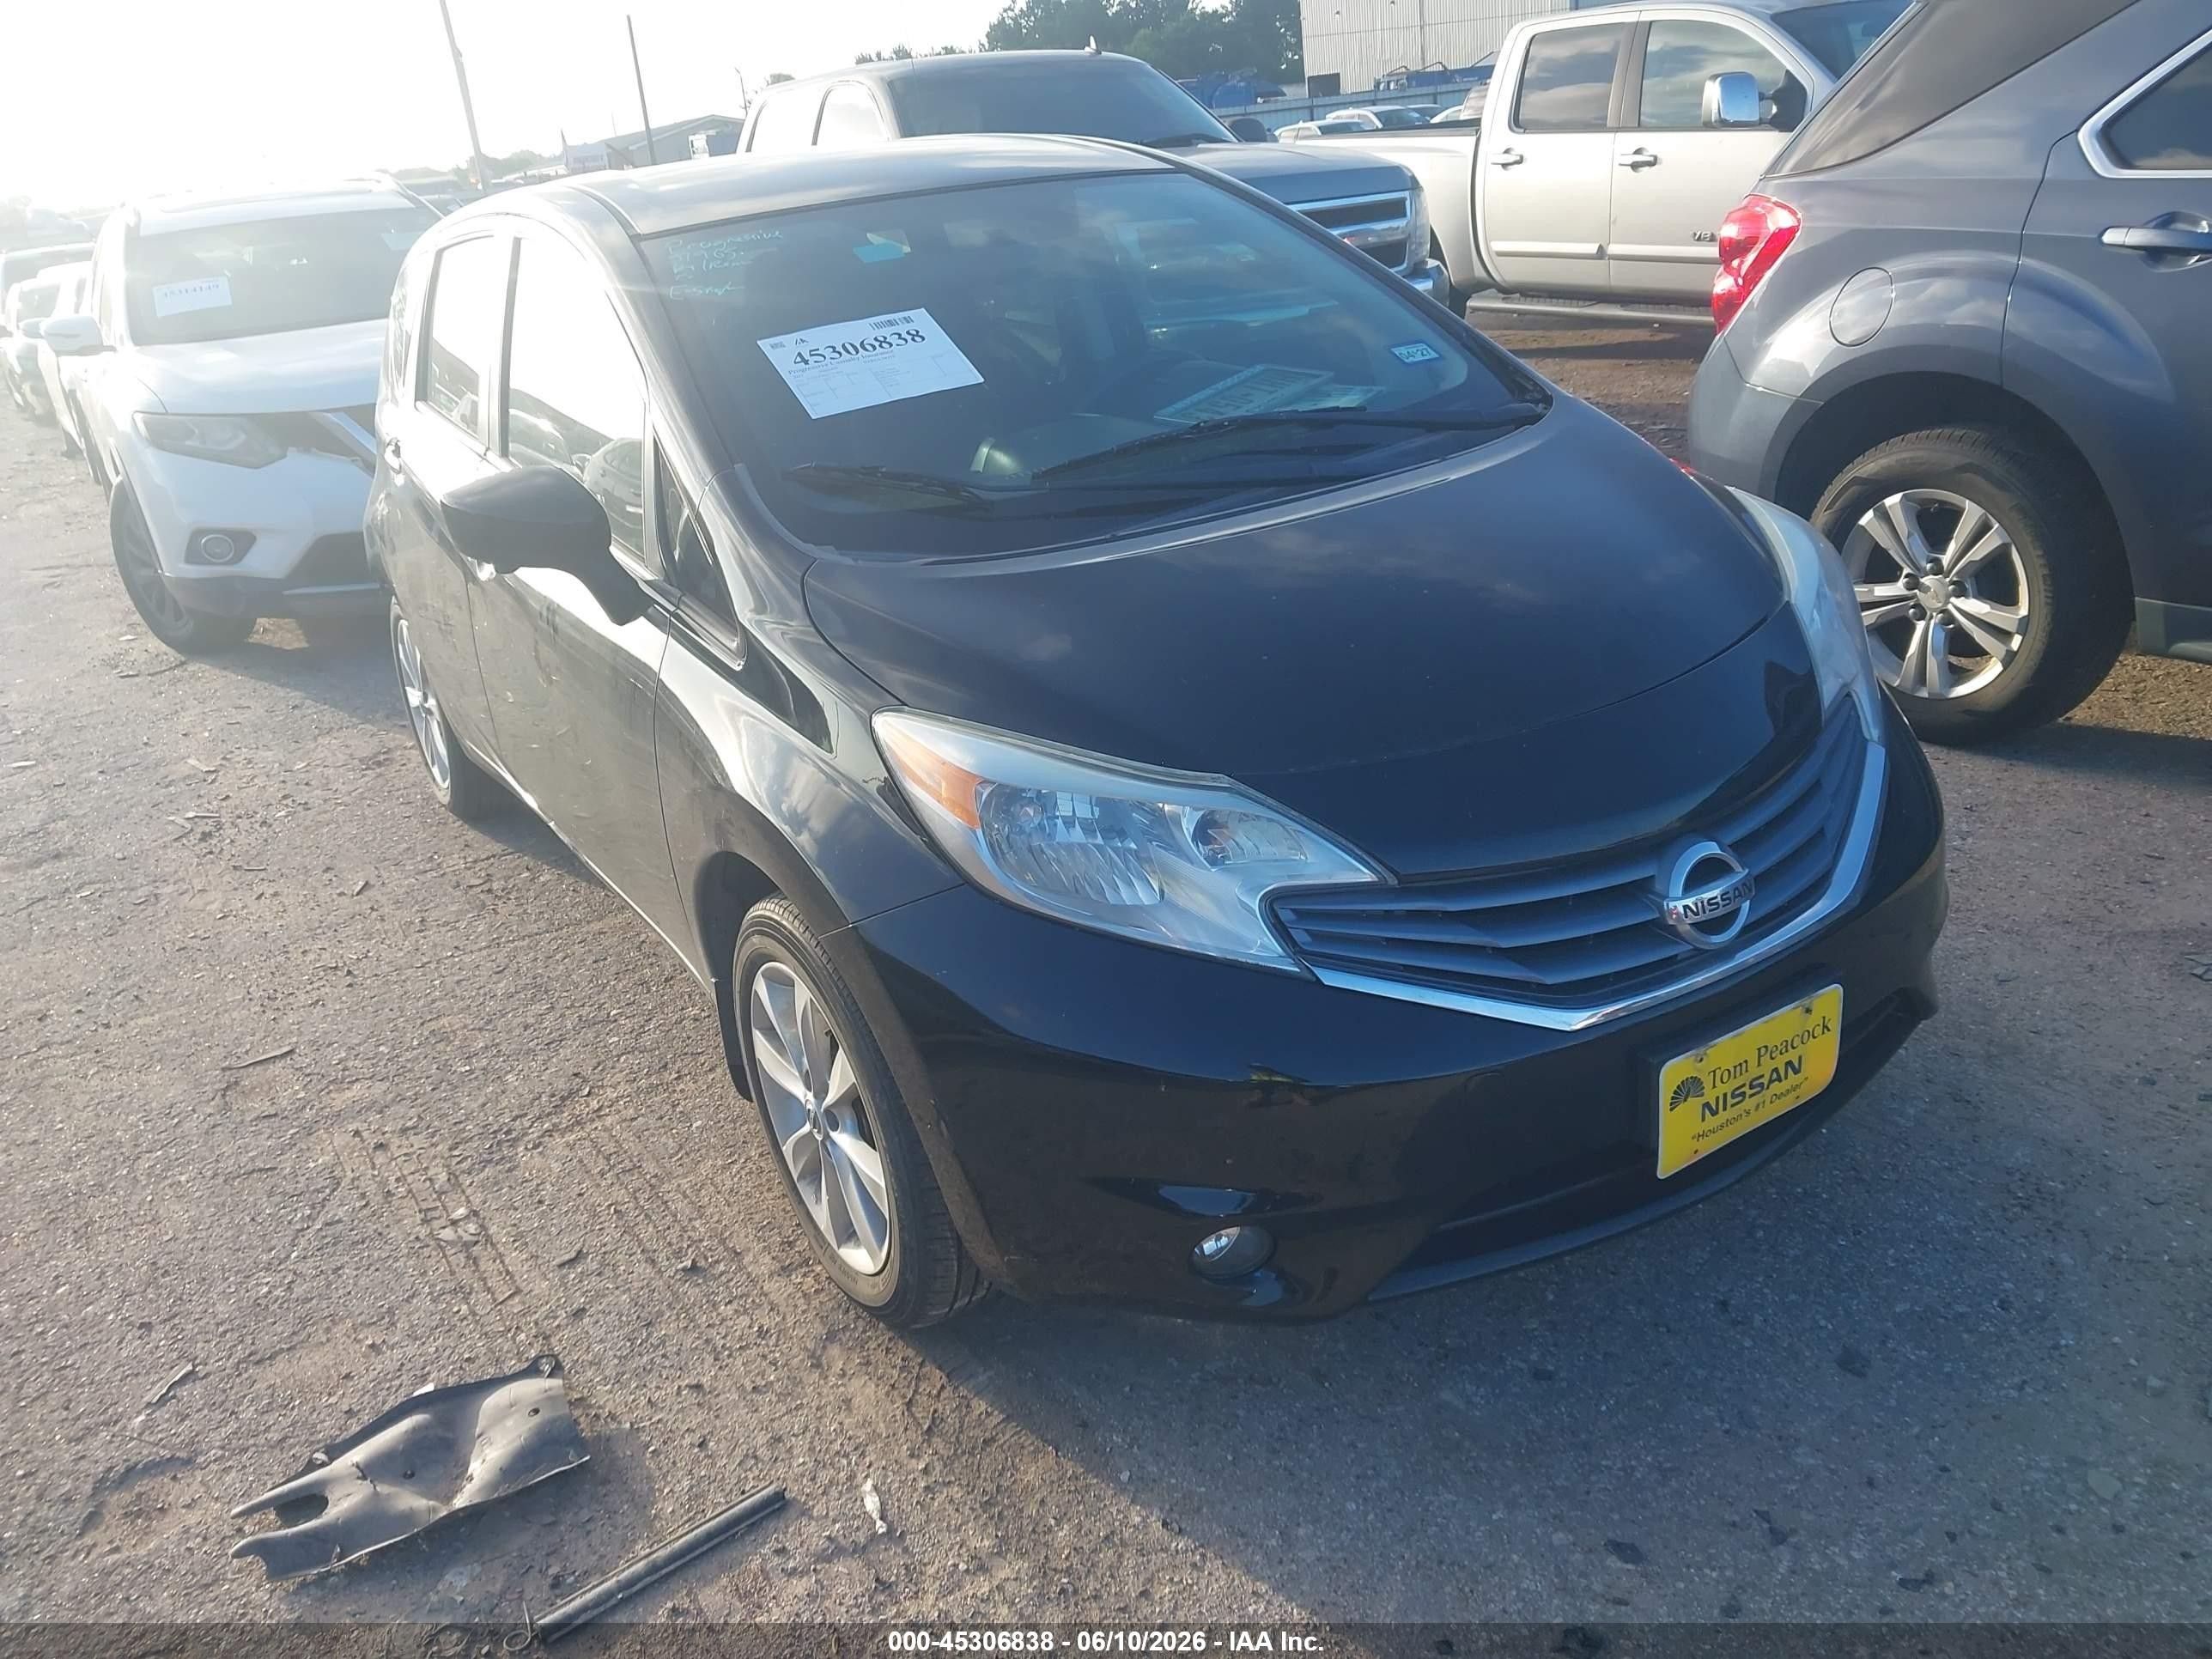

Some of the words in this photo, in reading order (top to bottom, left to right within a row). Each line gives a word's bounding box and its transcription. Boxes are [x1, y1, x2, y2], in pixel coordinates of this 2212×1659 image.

[793, 329, 926, 366] 45306838
[1683, 879, 1754, 919] NISSAN
[1707, 1059, 1749, 1090] Tom
[1756, 1016, 1832, 1067] Peacock
[1700, 1055, 1803, 1122] NISSAN
[1753, 1097, 1766, 1112] #1
